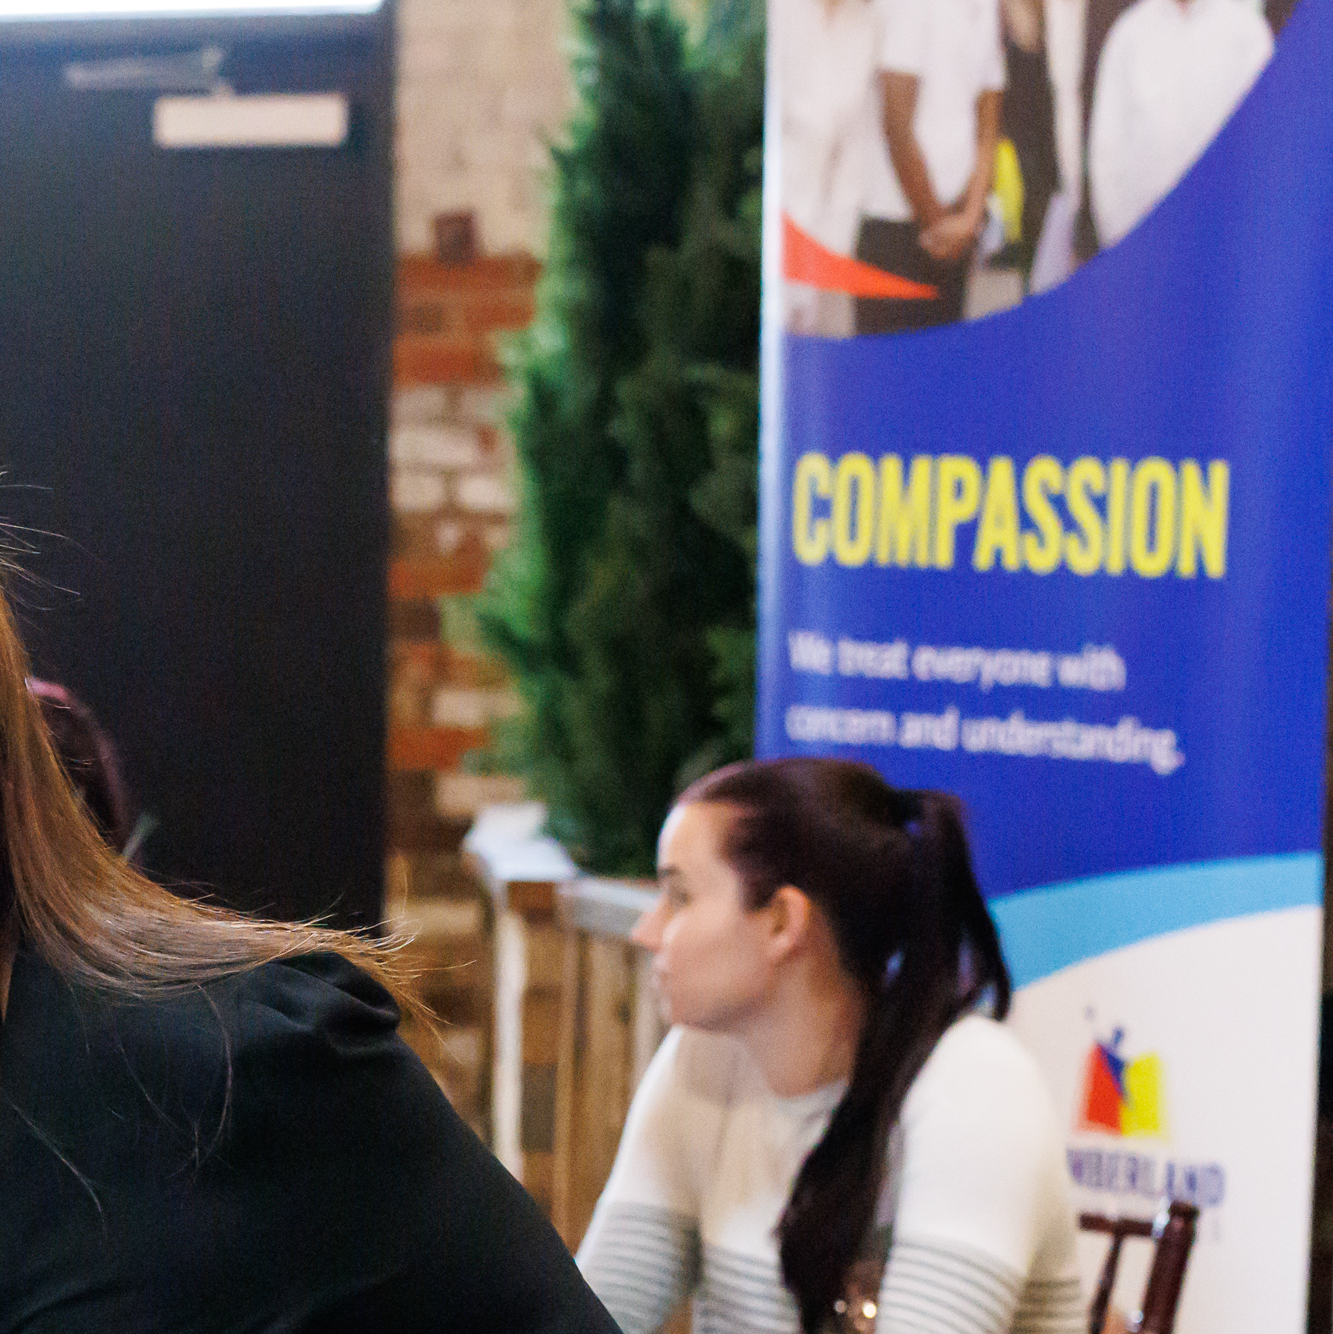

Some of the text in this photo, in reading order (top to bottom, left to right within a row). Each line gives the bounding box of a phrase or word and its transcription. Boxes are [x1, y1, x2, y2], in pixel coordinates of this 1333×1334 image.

[792, 450, 1230, 580] COMPASSION
[787, 631, 1127, 693] We treat everyone with
[784, 703, 897, 747] concern
[899, 706, 961, 751] and
